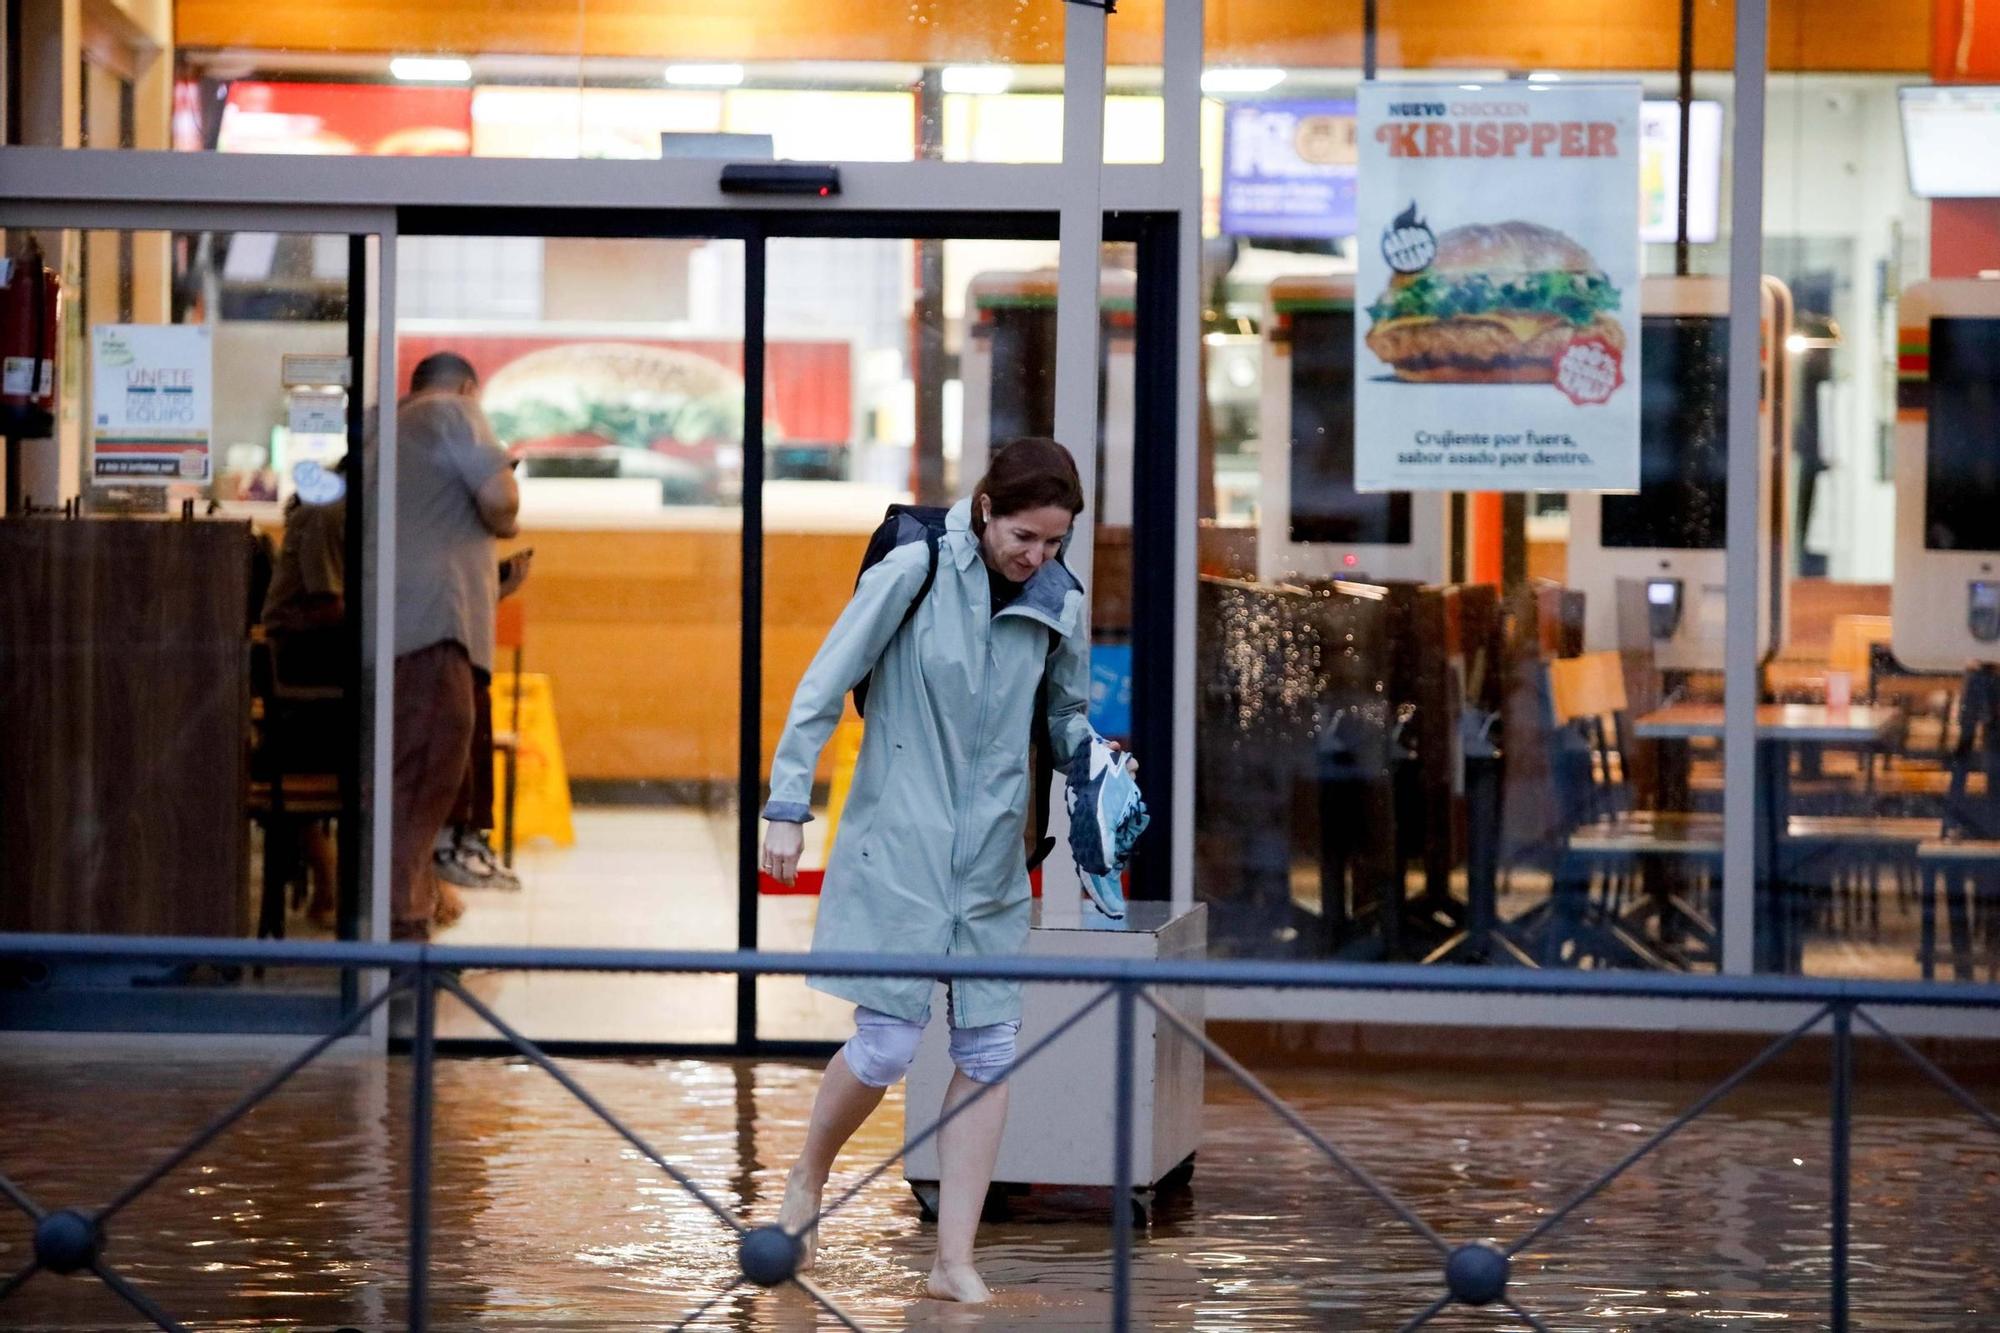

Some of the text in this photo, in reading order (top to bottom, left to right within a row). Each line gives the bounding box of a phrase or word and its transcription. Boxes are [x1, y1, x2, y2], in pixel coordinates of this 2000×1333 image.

[1388, 102, 1529, 117] NUEVO CHICKEN
[1375, 121, 1618, 158] KRISPPER
[1415, 429, 1576, 448] Crujiente por fuera,
[1398, 449, 1594, 467] sabor asado por dentro.
